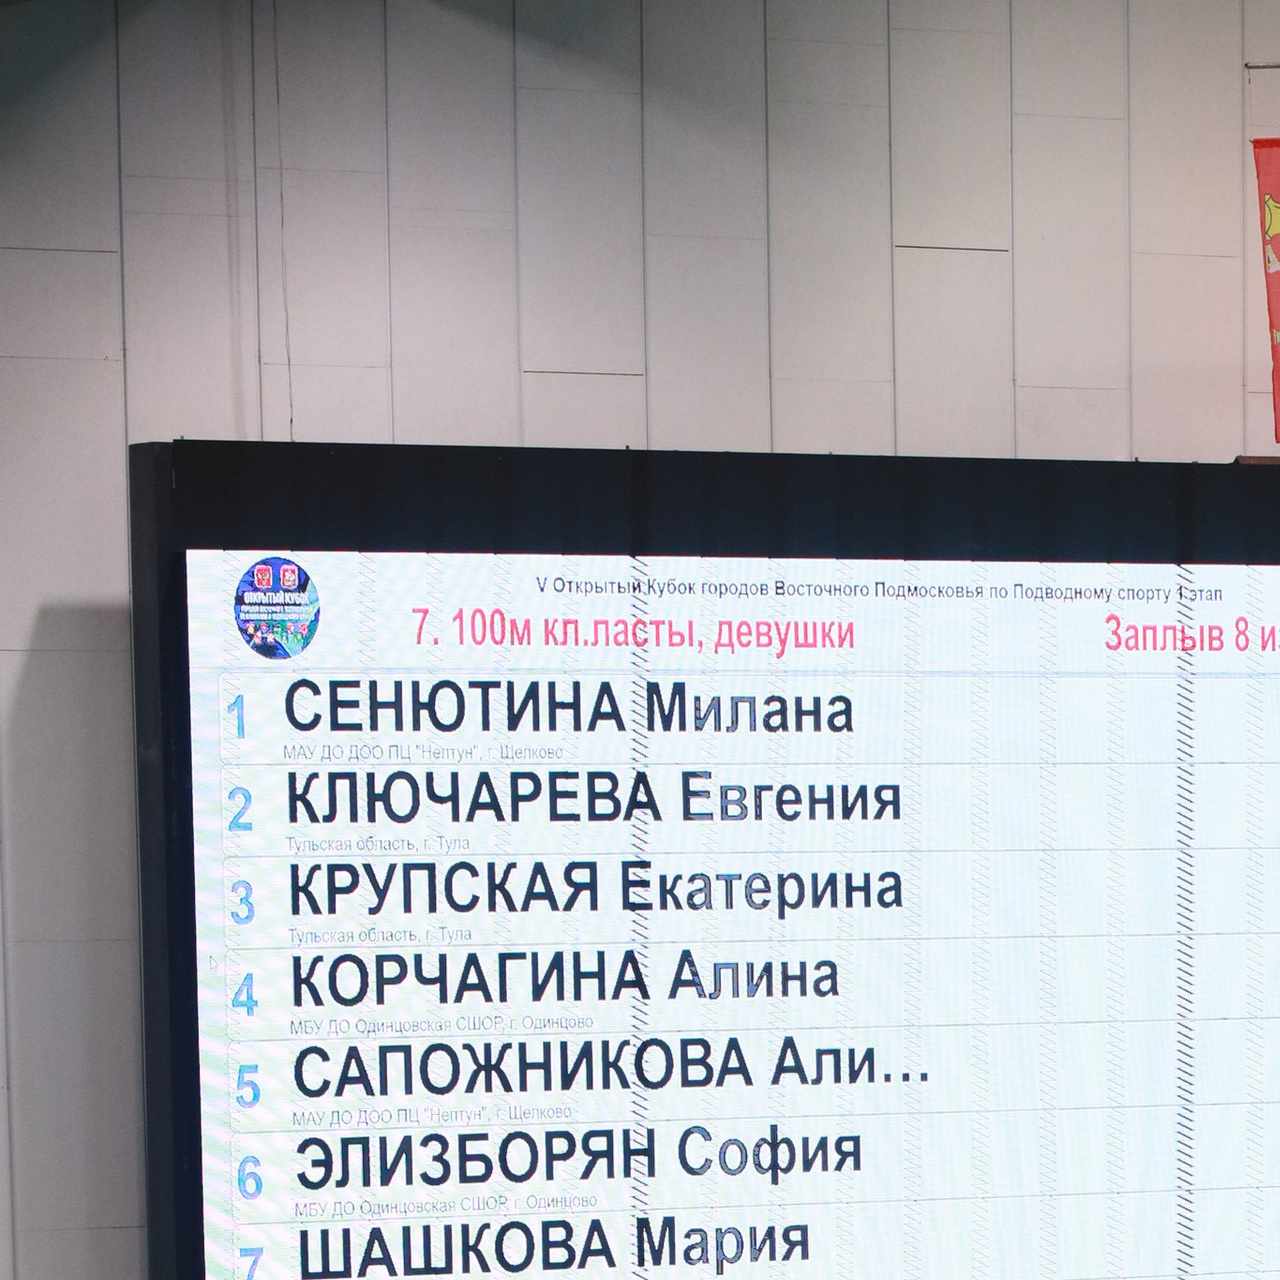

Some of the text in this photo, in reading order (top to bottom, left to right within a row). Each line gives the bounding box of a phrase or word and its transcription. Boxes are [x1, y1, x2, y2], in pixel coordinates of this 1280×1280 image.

[536, 576, 548, 593] V
[553, 575, 643, 597] Открытый
[647, 577, 696, 597] Кубок
[700, 581, 769, 598] городов
[775, 580, 869, 597] Восточного
[874, 581, 984, 600] Подмосковья
[989, 586, 1008, 599] по
[1013, 584, 1112, 602] Подводному
[1117, 587, 1171, 604] спорту
[1190, 587, 1223, 602] этап
[411, 607, 855, 659] 7. 100м кл.ласты, девушки
[1104, 613, 1224, 652] Заплыв
[1234, 616, 1250, 652] 8
[226, 678, 854, 739] 1 СЕНЮТИНА Милана
[283, 744, 318, 760] МАУ
[320, 745, 344, 762] ДО
[348, 745, 384, 762] ДОО
[388, 745, 411, 762] ПЦ
[500, 745, 564, 761] Щелково
[227, 771, 901, 832] 2 КЛЮЧАРЕВА Евгения
[285, 836, 352, 854] Тульская
[356, 835, 419, 852] область,
[435, 836, 470, 852] Тула
[230, 860, 904, 925] 3 КРУПСКАЯ Екатерина
[287, 928, 354, 944] Тульская
[358, 927, 421, 943] область,
[438, 927, 472, 943] Тула
[231, 949, 840, 1017] 4 КОРЧАГИНА Алина
[289, 1019, 323, 1035] МБУ
[327, 1019, 351, 1036] ДО
[355, 1017, 452, 1034] Одинцовская
[521, 1015, 594, 1030] Одинцово
[235, 1063, 261, 1109] 5
[293, 1037, 754, 1098] САПОЖНИКОВА
[292, 1110, 326, 1126] МАУ
[329, 1110, 353, 1126] ДО
[357, 1109, 393, 1125] ДОО
[396, 1108, 420, 1125] ПЦ
[507, 1105, 572, 1122] Щелково
[236, 1124, 861, 1201] 6 ЭЛИЗБОРЯН София
[294, 1201, 328, 1218] МБУ
[331, 1200, 355, 1218] ДО
[359, 1198, 456, 1215] Одинцовская
[525, 1194, 598, 1210] Одинцово
[299, 1218, 617, 1280] ШАШКОВА
[635, 1216, 810, 1276] Мария
